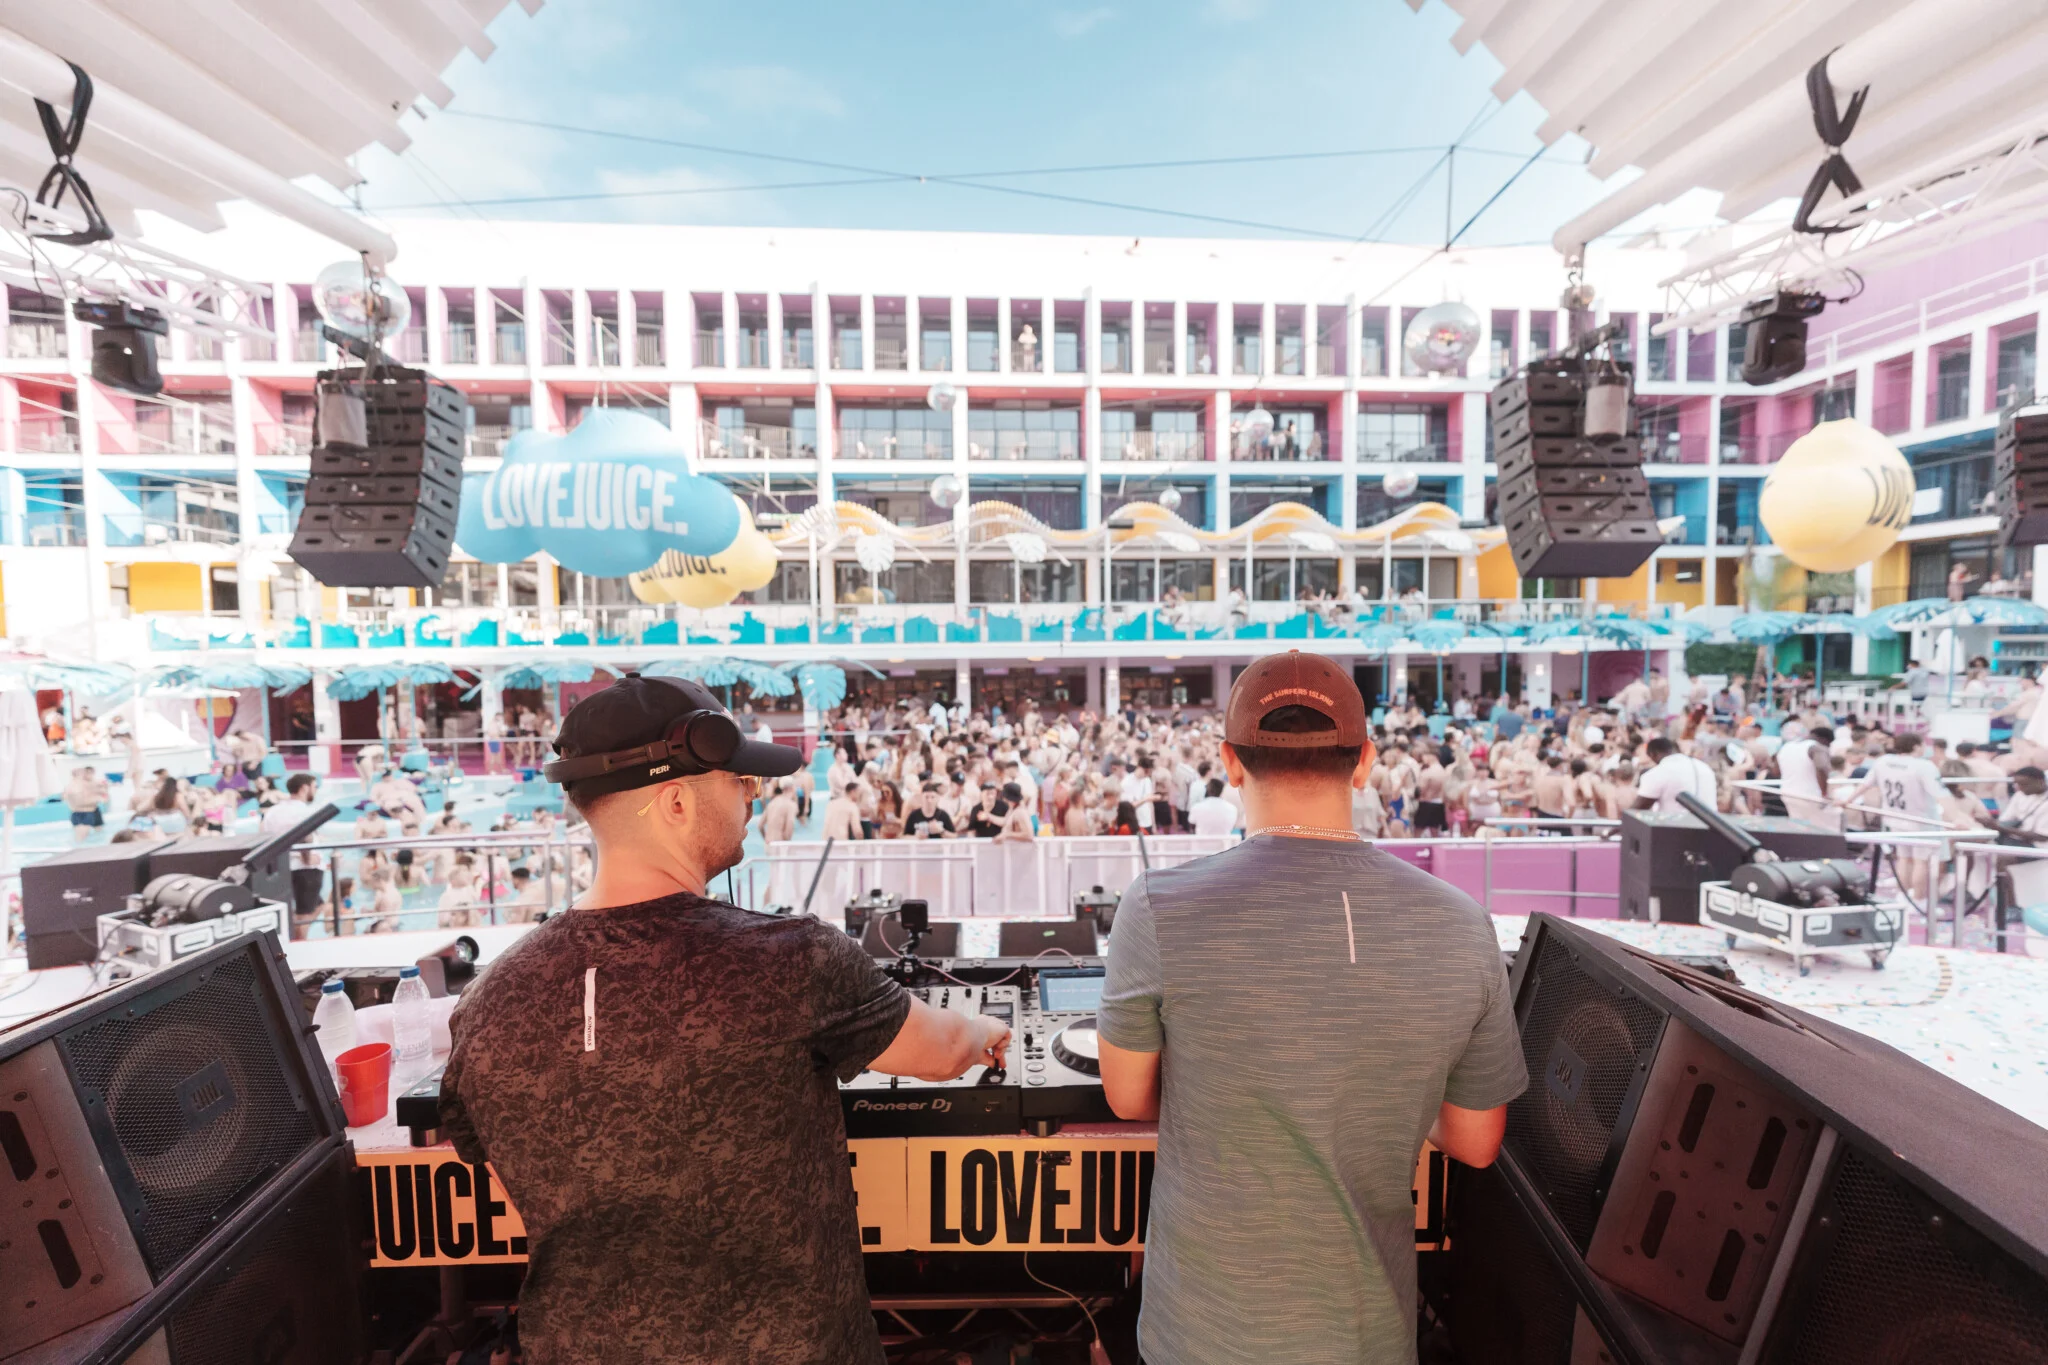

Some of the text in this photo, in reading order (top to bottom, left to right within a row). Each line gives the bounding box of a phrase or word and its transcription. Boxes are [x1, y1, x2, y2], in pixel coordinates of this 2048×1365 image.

[482, 461, 689, 536] LOVEJUICE.
[1274, 688, 1308, 698] SURFERS
[1884, 779, 1907, 810] 22
[852, 1098, 928, 1113] Pioneer
